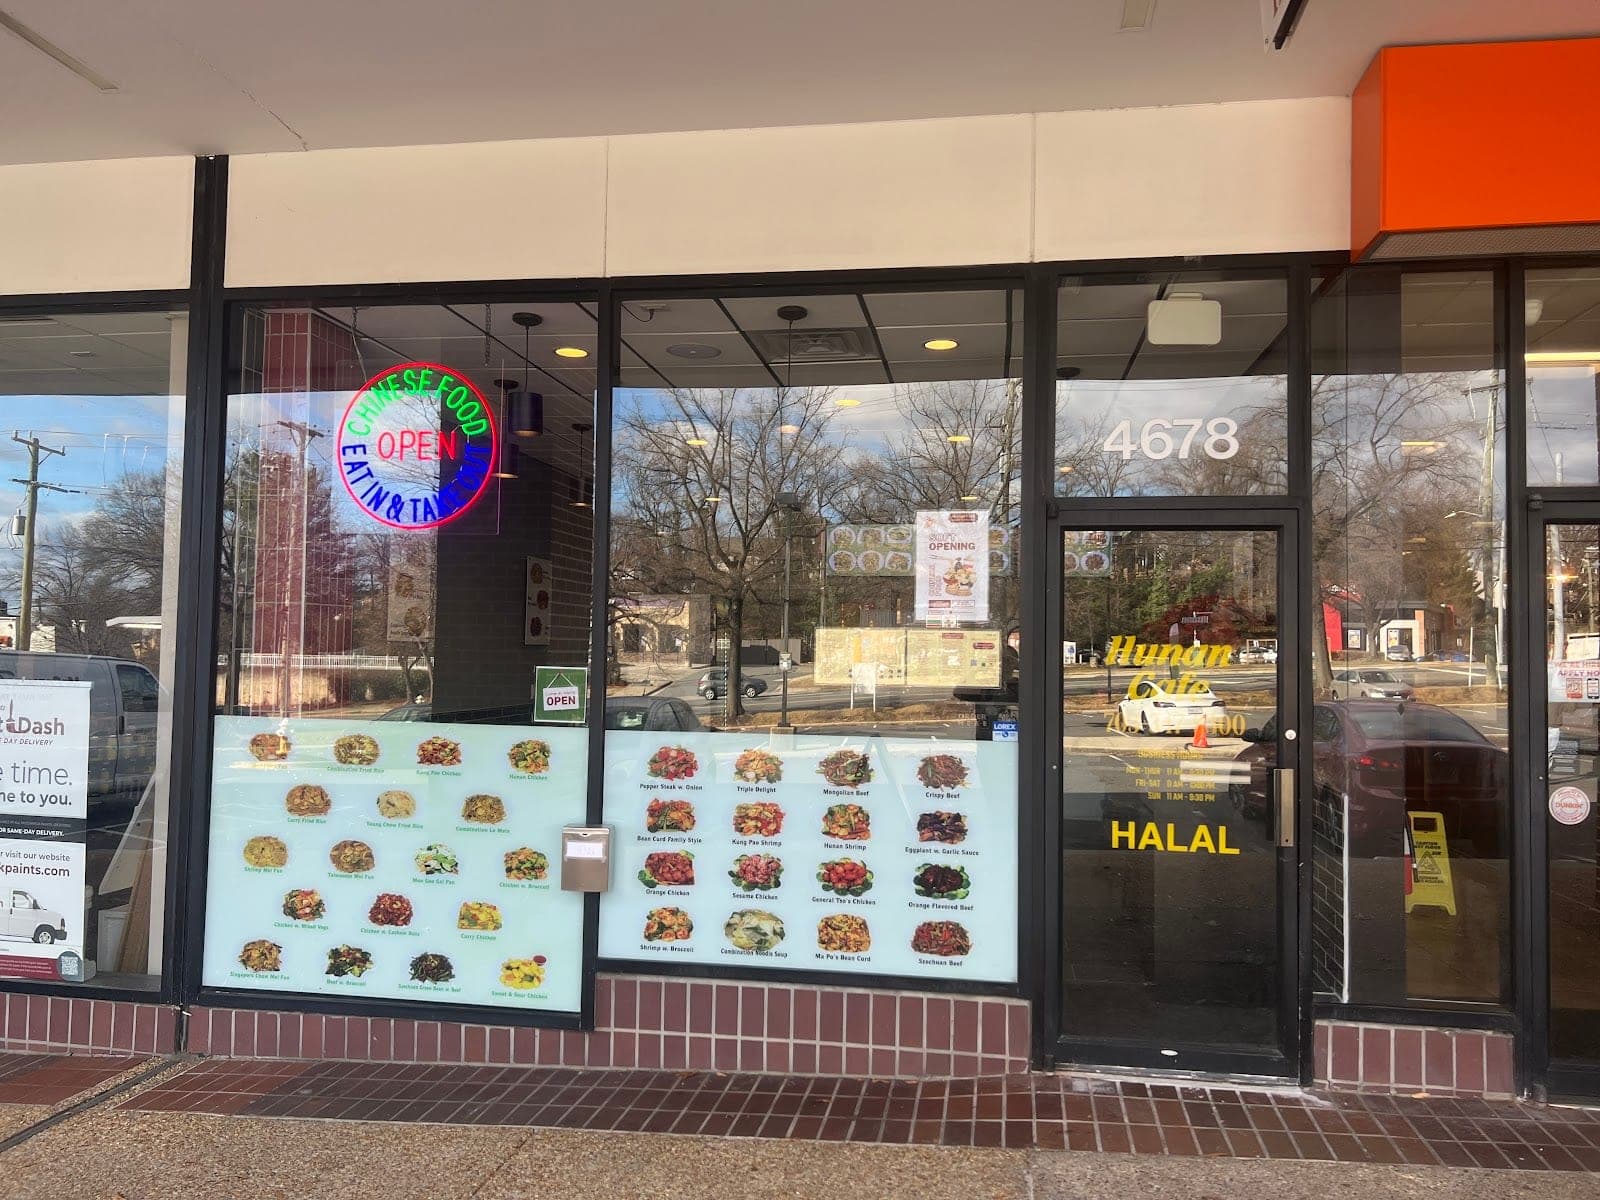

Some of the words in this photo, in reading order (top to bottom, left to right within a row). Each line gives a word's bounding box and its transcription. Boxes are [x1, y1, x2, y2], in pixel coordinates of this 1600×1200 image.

[347, 369, 433, 437] CHINESE
[434, 375, 489, 436] FOOD
[1103, 417, 1239, 460] 4678
[378, 430, 457, 461] OPEN
[342, 443, 374, 485] EAT
[361, 481, 389, 512] IN
[386, 493, 405, 522] &
[928, 542, 976, 551] OPENING
[1104, 635, 1233, 668] Hunan
[546, 696, 576, 706] OPEN
[18, 716, 65, 735] Dash
[11, 760, 72, 785] time.
[639, 783, 659, 791] Pepper
[823, 788, 854, 797] Mongolian
[925, 791, 944, 799] Crispy
[1147, 792, 1161, 800] SUN
[1166, 792, 1172, 800] 11
[1173, 792, 1184, 801] AM
[1205, 793, 1216, 802] PM
[20, 790, 35, 804] to
[40, 793, 72, 807] you.
[1111, 820, 1240, 855] HALAL
[844, 843, 867, 851] Shrimp
[904, 846, 932, 854] Eggplant
[5, 850, 21, 859] visit
[39, 852, 71, 861] website
[499, 881, 520, 889] Chicken
[528, 882, 550, 890] Broccoli
[645, 888, 666, 896] Orange
[732, 892, 754, 900] Sesame
[812, 896, 835, 904] General
[908, 902, 930, 910] Orange
[931, 903, 958, 911] Flavored
[460, 933, 475, 941] Curry
[640, 944, 661, 952] Shrimp
[670, 945, 694, 953] Broccoli
[720, 948, 754, 956] Combination
[755, 949, 774, 957] Noodle
[918, 958, 947, 966] Szechuan
[948, 959, 963, 967] Beef
